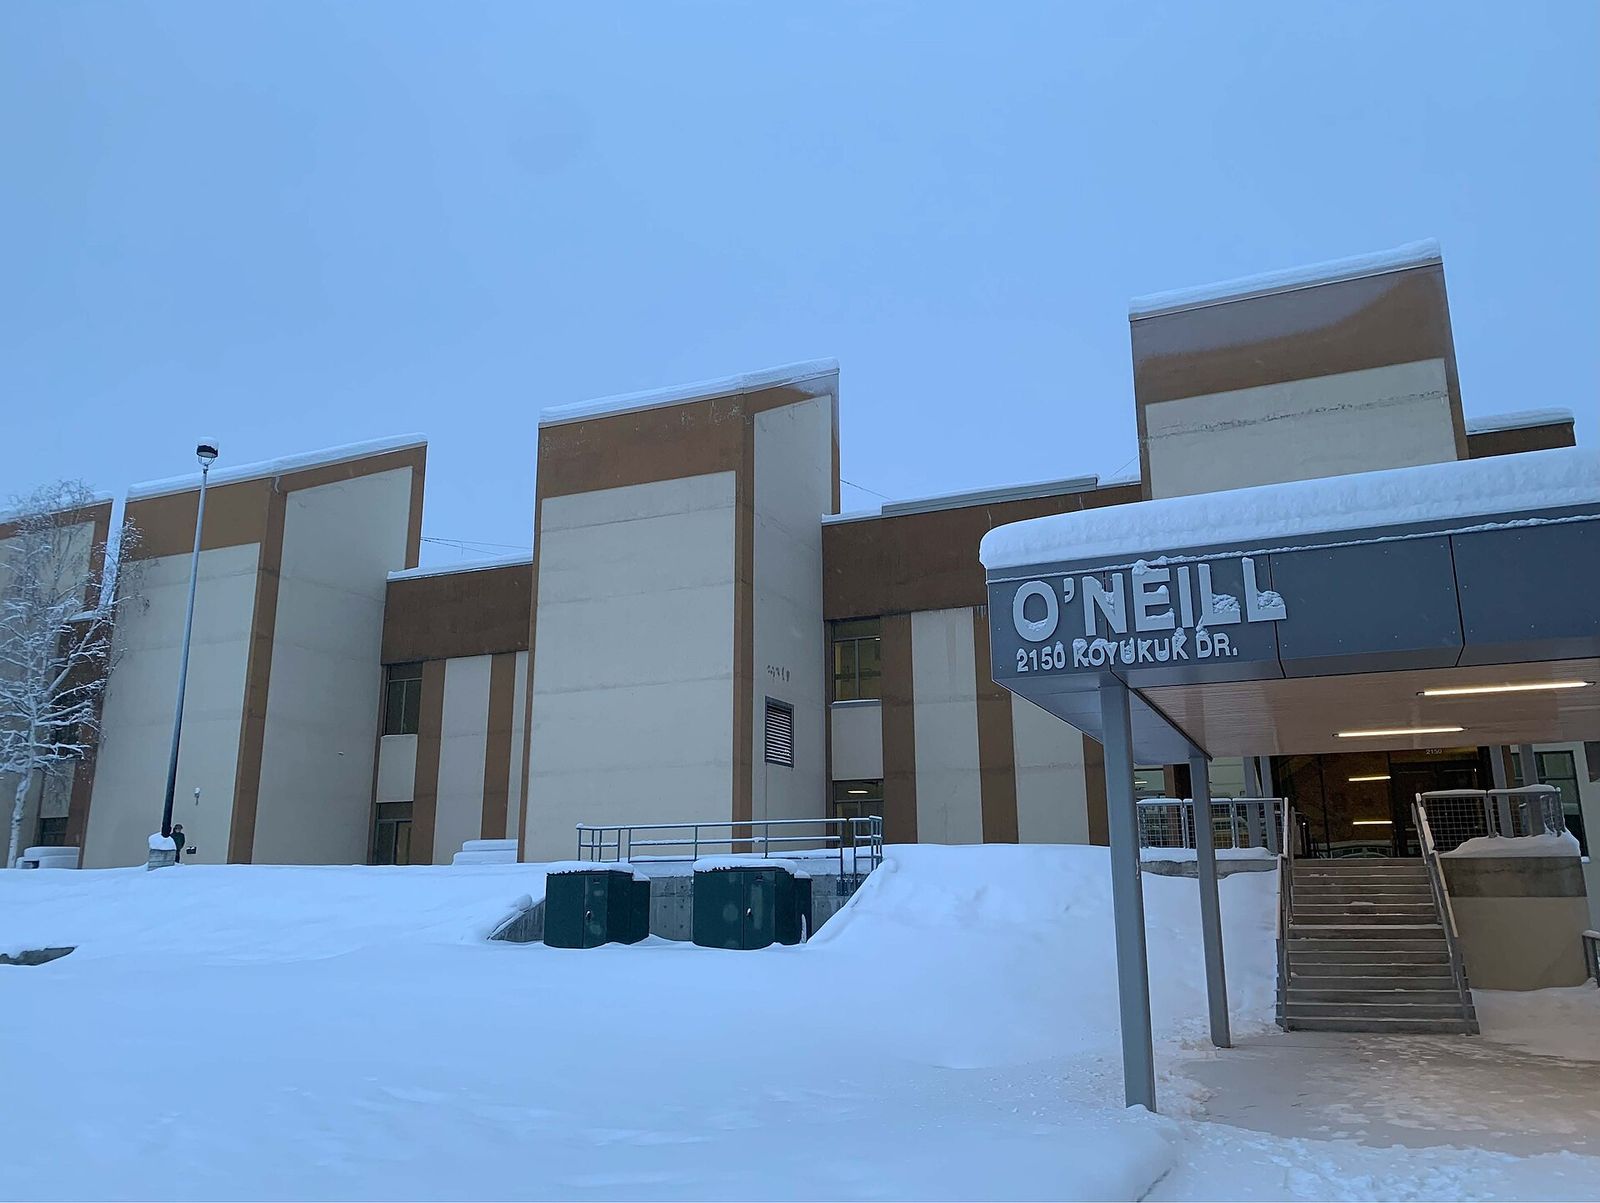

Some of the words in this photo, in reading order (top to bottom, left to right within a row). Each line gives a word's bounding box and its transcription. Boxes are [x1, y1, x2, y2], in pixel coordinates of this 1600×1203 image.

[1013, 557, 1287, 642] O'NEILL
[1016, 642, 1066, 672] 2150
[1072, 632, 1189, 667] KOYUKUK
[1196, 632, 1239, 659] DR.
